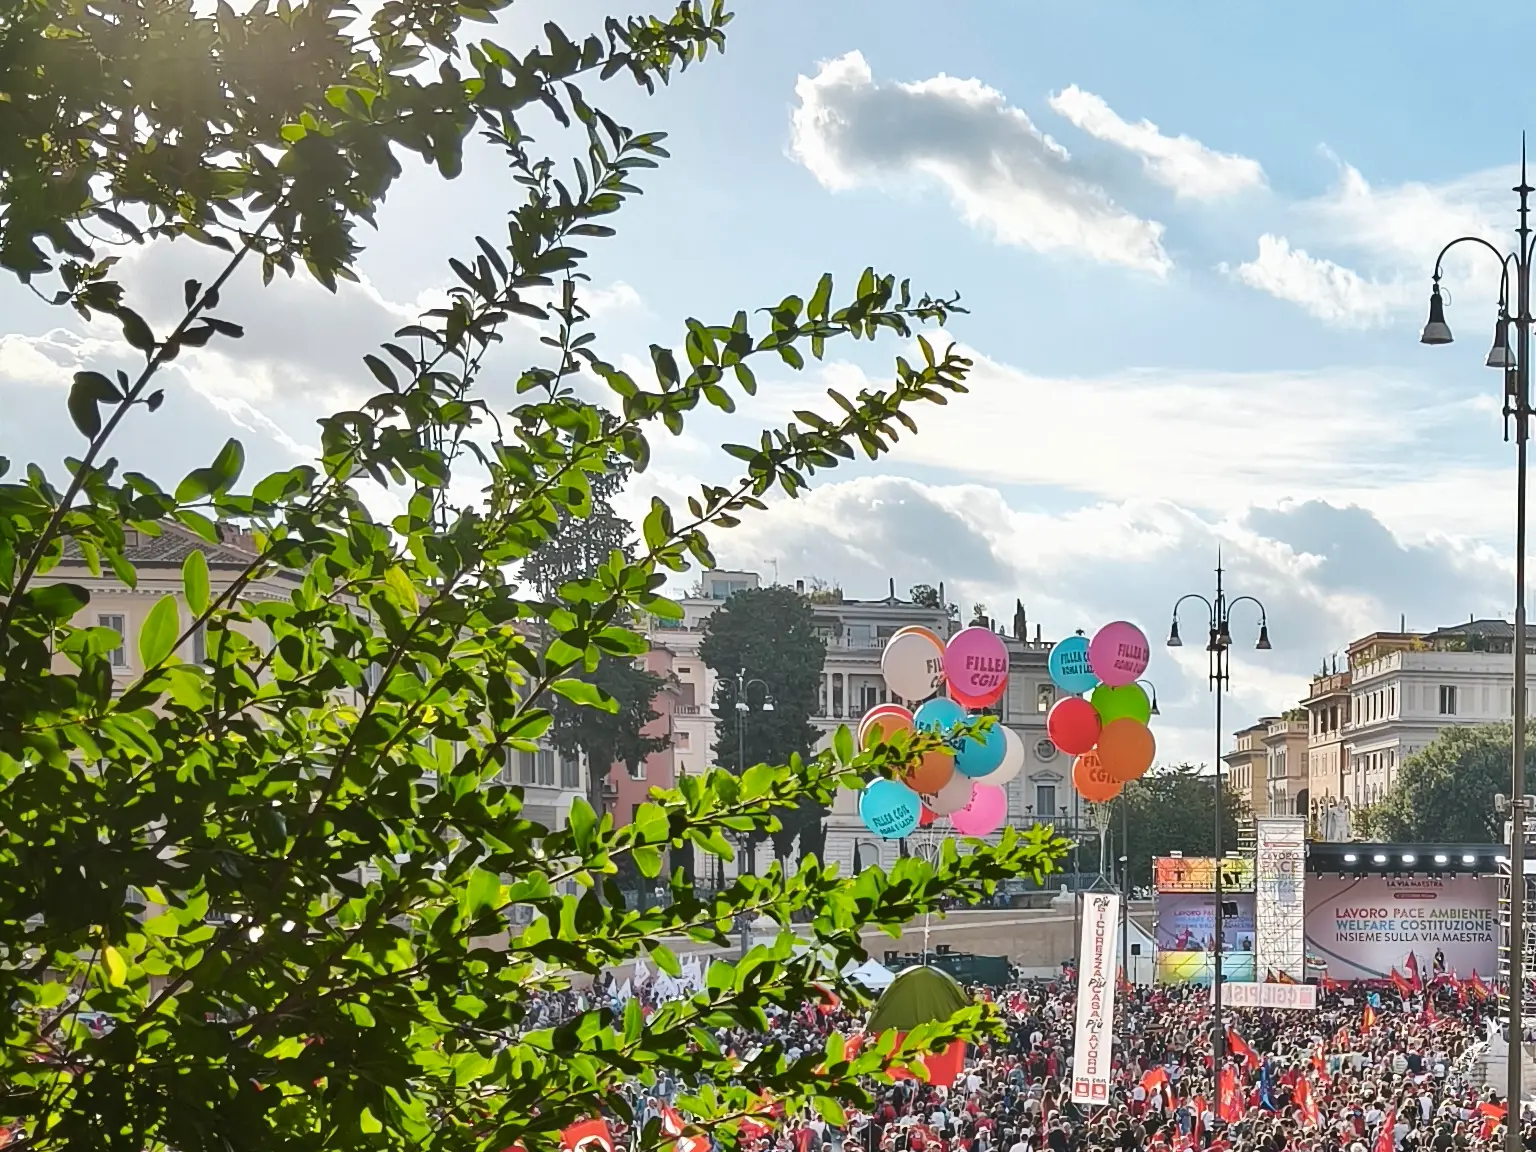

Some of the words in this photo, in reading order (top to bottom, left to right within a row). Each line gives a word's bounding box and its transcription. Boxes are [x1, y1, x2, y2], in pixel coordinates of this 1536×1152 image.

[966, 655, 1007, 673] FILLEA
[970, 673, 1000, 688] CGIL
[1335, 908, 1388, 919] LAVORO
[1393, 908, 1425, 919] PACE
[1429, 908, 1492, 920] AMBIENTE
[1336, 920, 1396, 931] WELFARE
[1400, 920, 1492, 931] COSTITUZIONE
[1336, 932, 1382, 942] INSIEME
[1384, 932, 1419, 942] SULLA
[1421, 932, 1440, 942] VIA
[1442, 932, 1493, 943] MAESTRA
[1091, 986, 1102, 1018] CASA
[1087, 1026, 1099, 1075] LAVORO
